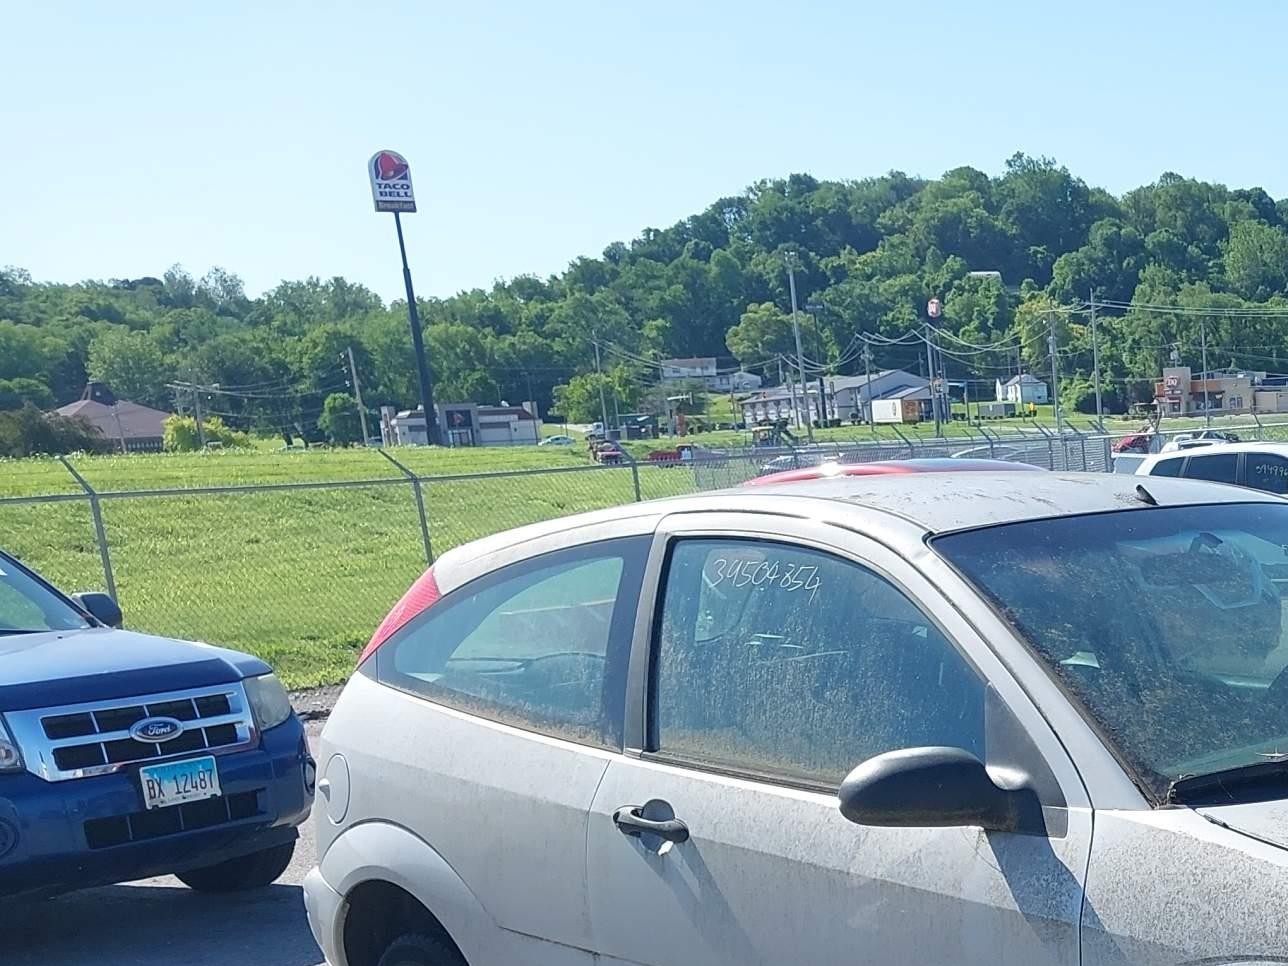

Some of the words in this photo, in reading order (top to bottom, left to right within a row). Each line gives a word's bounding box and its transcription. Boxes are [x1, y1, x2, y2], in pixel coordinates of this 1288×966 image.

[379, 190, 412, 198] BELL
[148, 723, 171, 736] Ford
[146, 776, 165, 800] BX
[173, 769, 214, 795] 12487
